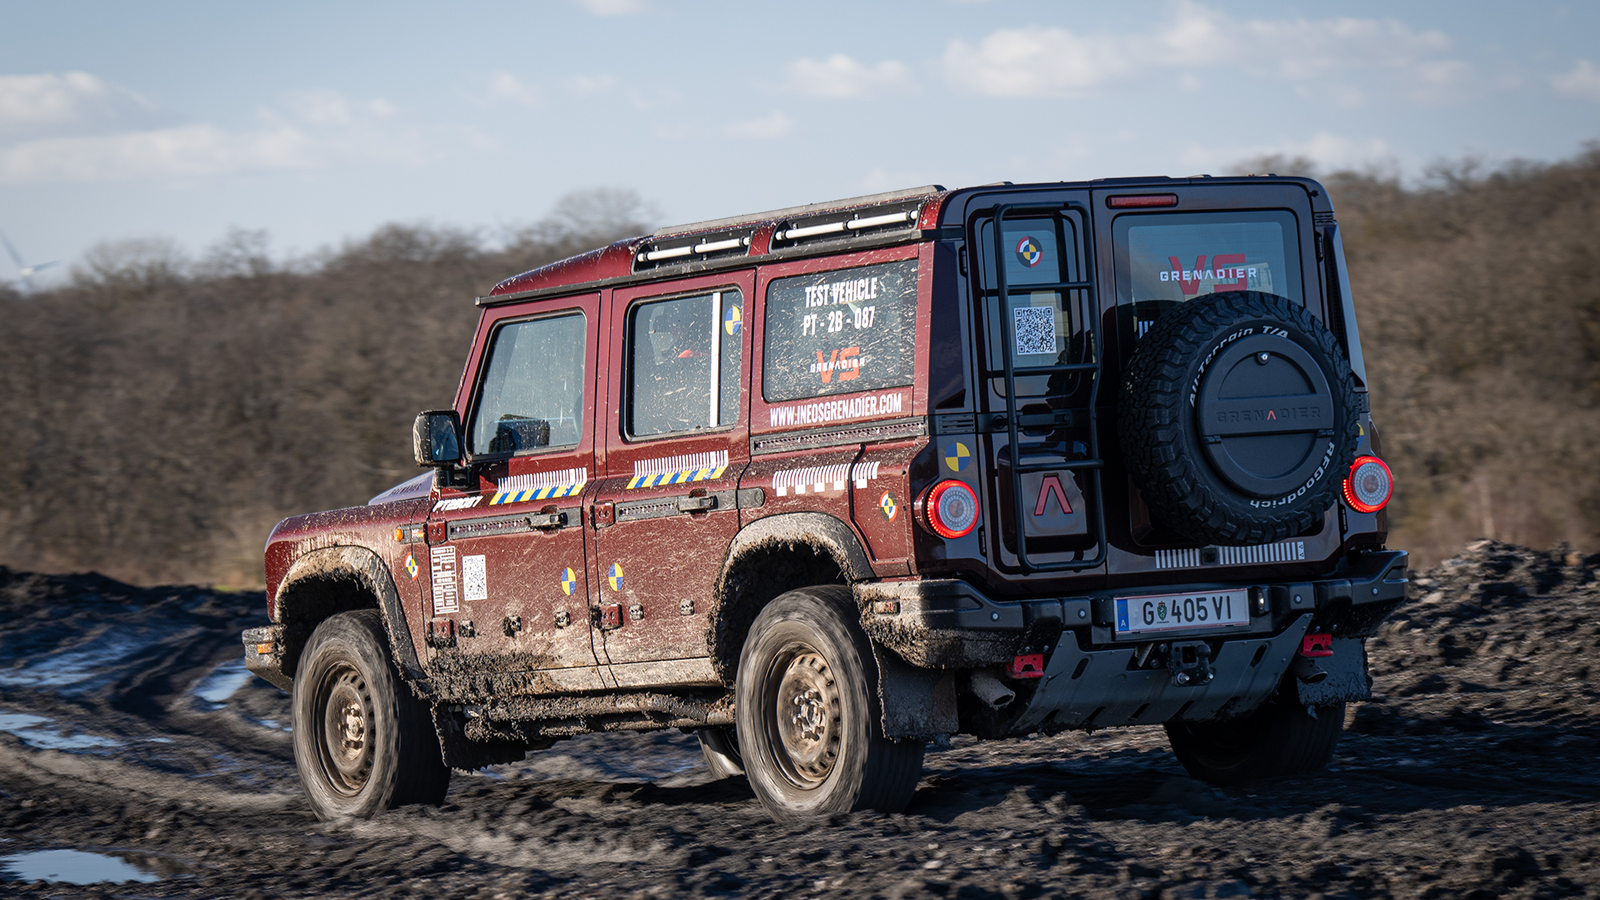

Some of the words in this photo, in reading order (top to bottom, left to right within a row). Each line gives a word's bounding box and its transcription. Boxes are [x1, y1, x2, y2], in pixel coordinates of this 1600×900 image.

[1159, 267, 1258, 282] GRENADIER
[804, 285, 830, 308] TEST
[831, 277, 878, 304] VEHICLE
[802, 313, 818, 336] PT
[828, 310, 843, 333] 2B
[854, 305, 876, 329] 087
[1262, 325, 1289, 339] T/A
[810, 357, 866, 373] GRENADIER
[769, 393, 902, 427] WWW.INEOSGRENADIER.COM
[1216, 406, 1321, 423] GRENADIER
[1142, 601, 1155, 625] G
[1120, 619, 1127, 627] A
